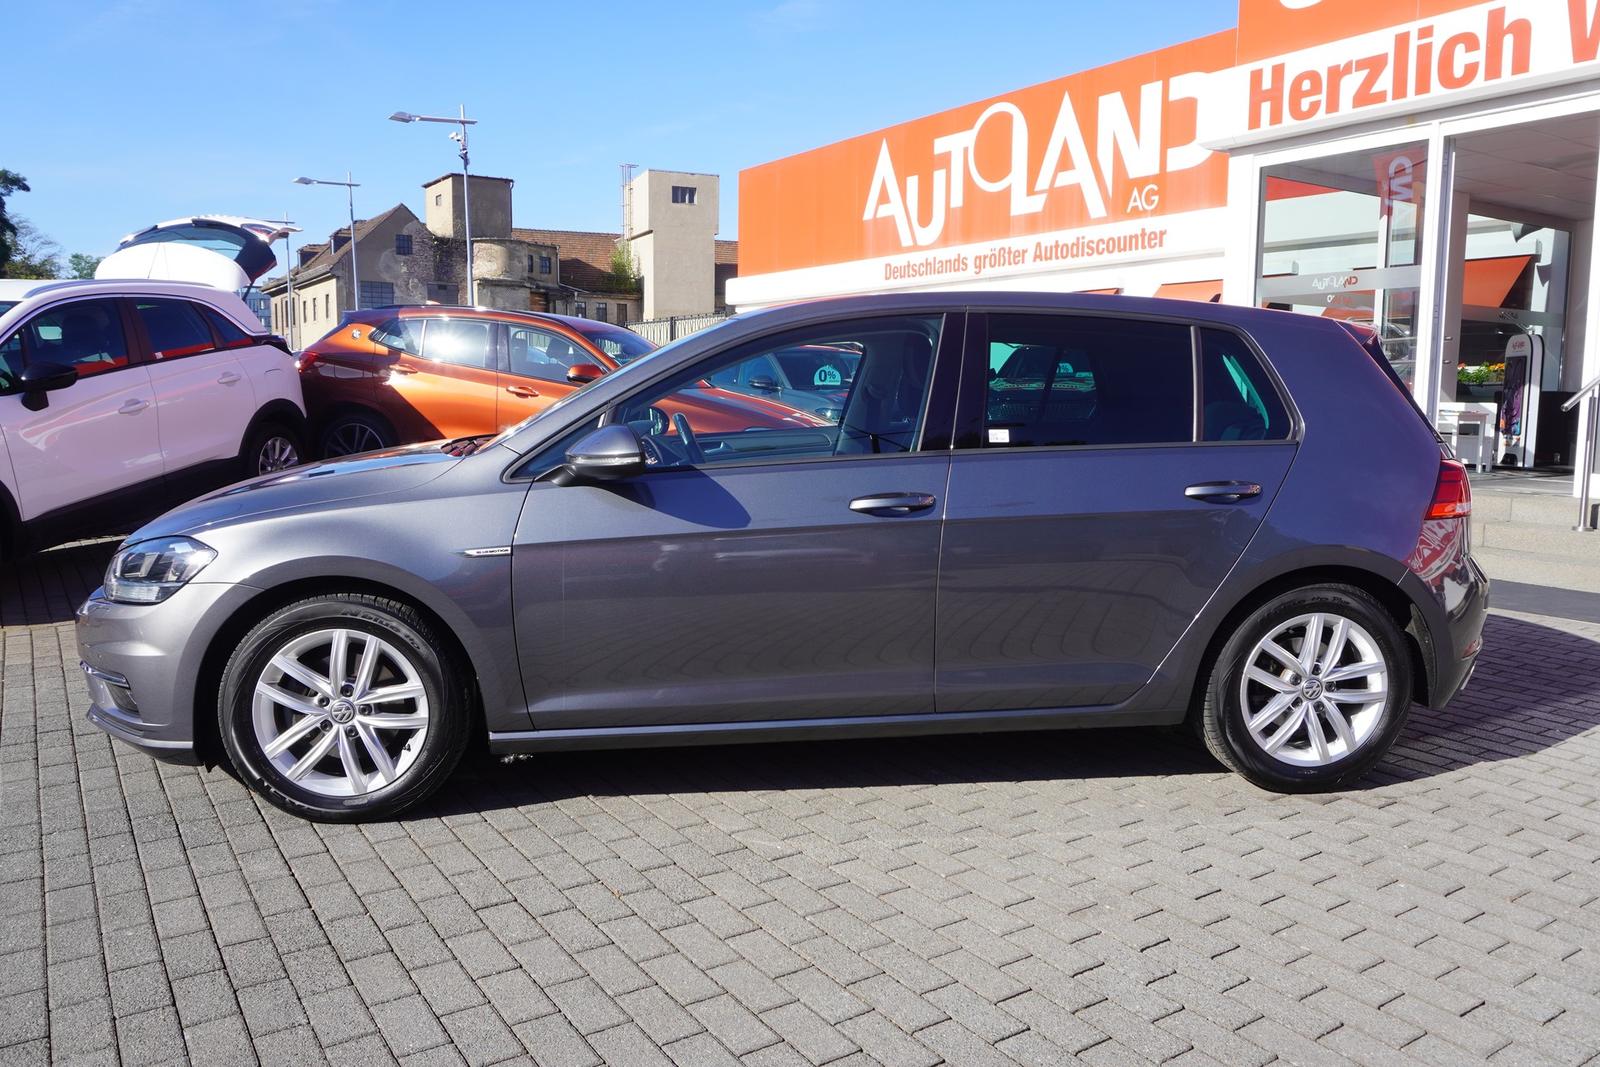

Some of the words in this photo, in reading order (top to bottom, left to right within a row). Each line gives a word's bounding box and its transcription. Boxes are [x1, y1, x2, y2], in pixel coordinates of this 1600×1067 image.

[1248, 6, 1532, 131] Herzlich
[1126, 184, 1160, 213] AG
[884, 252, 968, 281] Deutschlands
[974, 248, 1028, 276] größter
[1033, 228, 1167, 262] Autodiscounter
